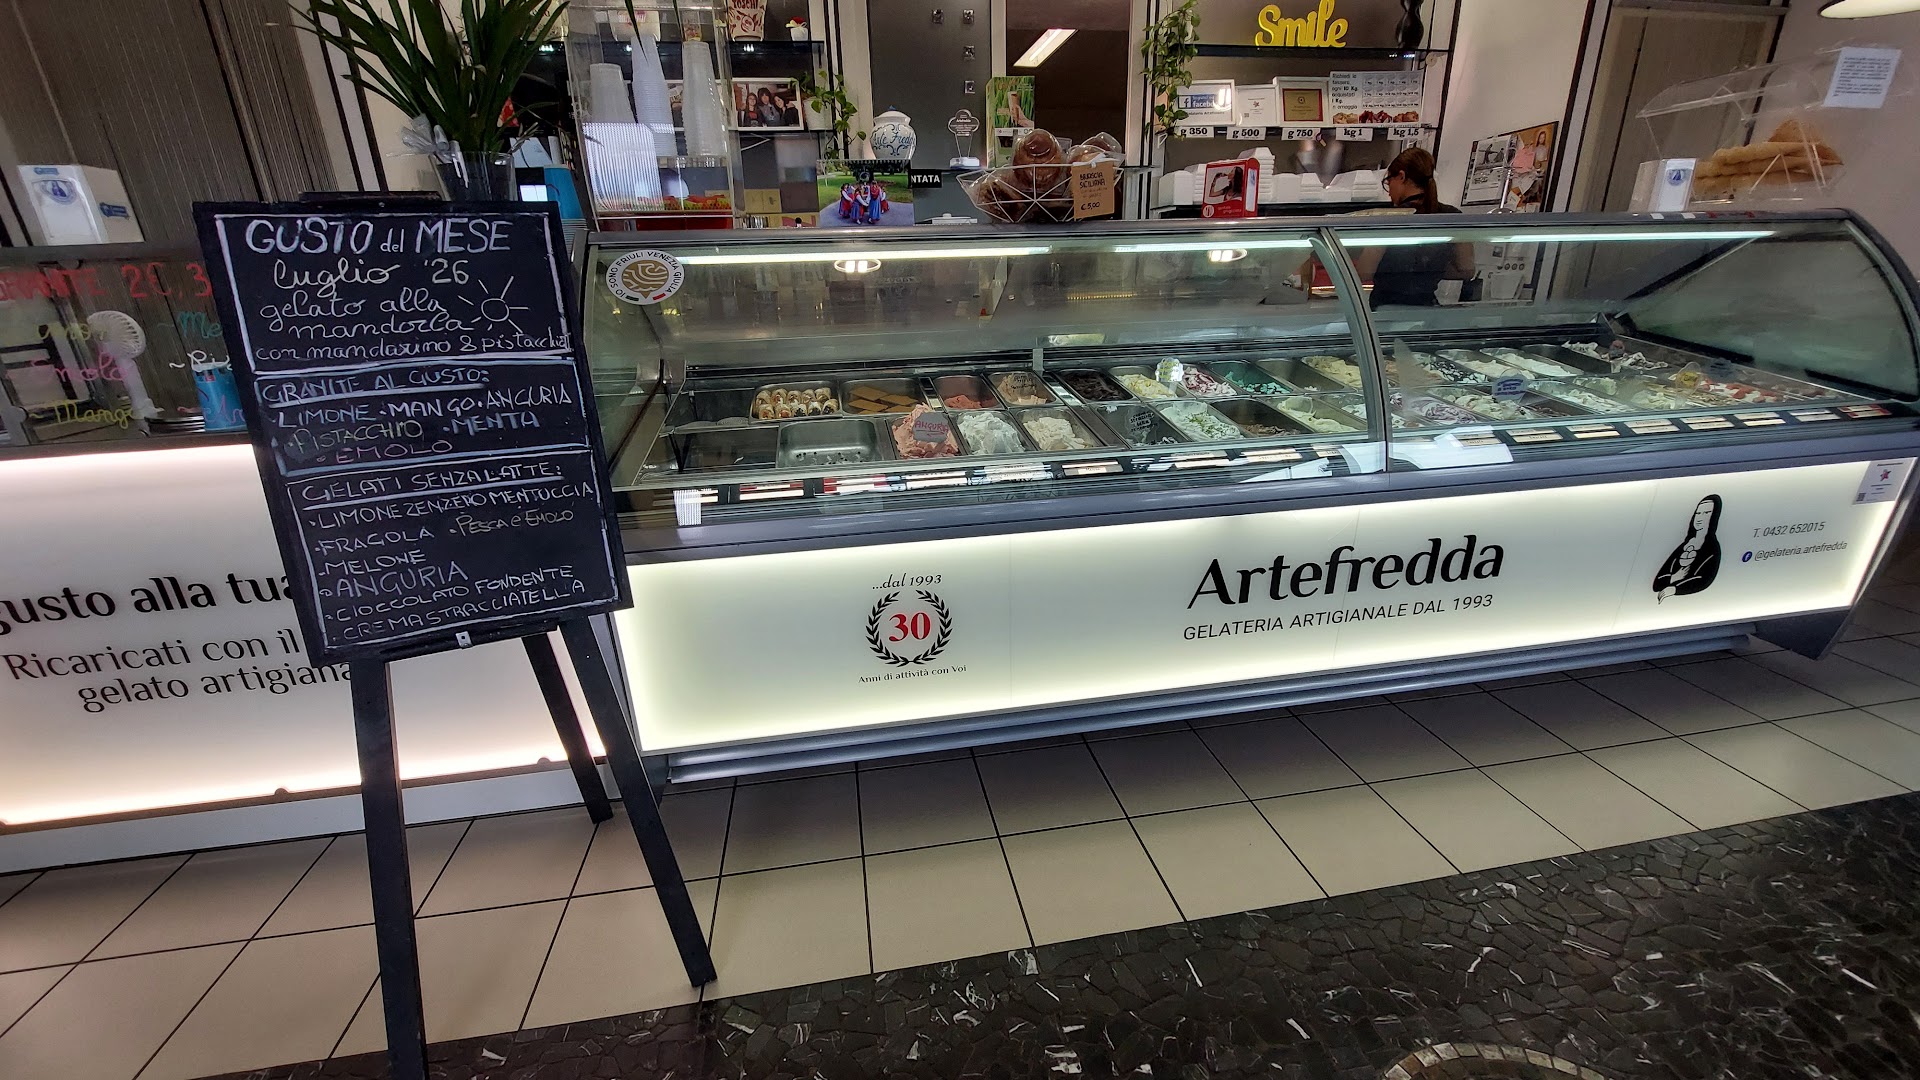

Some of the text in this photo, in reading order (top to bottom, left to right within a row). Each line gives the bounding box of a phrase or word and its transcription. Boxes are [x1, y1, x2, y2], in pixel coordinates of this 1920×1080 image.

[1255, 0, 1348, 47] Smile
[1189, 127, 1207, 135] 350
[1232, 130, 1239, 138] g
[1288, 130, 1294, 138] g
[1344, 129, 1356, 137] kg
[1393, 128, 1405, 137] kg
[245, 218, 513, 254] GUSTO del MESE
[274, 258, 470, 298] luglio '26
[609, 252, 682, 298] IO SONO FRIULI VENEZIA GIULIA
[260, 294, 366, 332] gelato
[380, 288, 450, 314] alla
[288, 312, 473, 340] mandorla
[256, 347, 300, 361] con
[306, 337, 452, 360] mandarino
[262, 369, 490, 402] GRANITE AL GUSTO:
[52, 402, 136, 430] Mang
[278, 404, 376, 428] LIMONE
[486, 382, 572, 410] ANGURIA
[294, 411, 540, 454] PISTACCHIO MENTA
[336, 440, 452, 464] EMOLO
[302, 476, 402, 500] GELATI
[318, 504, 402, 528] LIMONE
[488, 482, 594, 505] MENTUCCIA
[318, 526, 434, 556] FRAGOLA
[1763, 525, 1788, 537] 0432
[1789, 522, 1826, 534] 652015
[325, 550, 426, 576] MELONE
[1755, 541, 1848, 561] @gelateria.artefredda
[336, 561, 468, 598] ANGURIA
[910, 574, 942, 586] 1993
[1186, 534, 1504, 610] Artefredda
[130, 576, 216, 614] alla
[336, 566, 574, 622] CIOCCOLATO FONDENTE
[343, 580, 585, 640] CREMA STRACCIATELLA
[1183, 594, 1493, 640] GELATERIA ARTIGIANALE DAL 1993
[888, 612, 931, 642] 30
[4, 629, 300, 680] Ricaricati con il
[858, 665, 967, 684] Anni di attività con Voi
[78, 675, 189, 712] gelato
